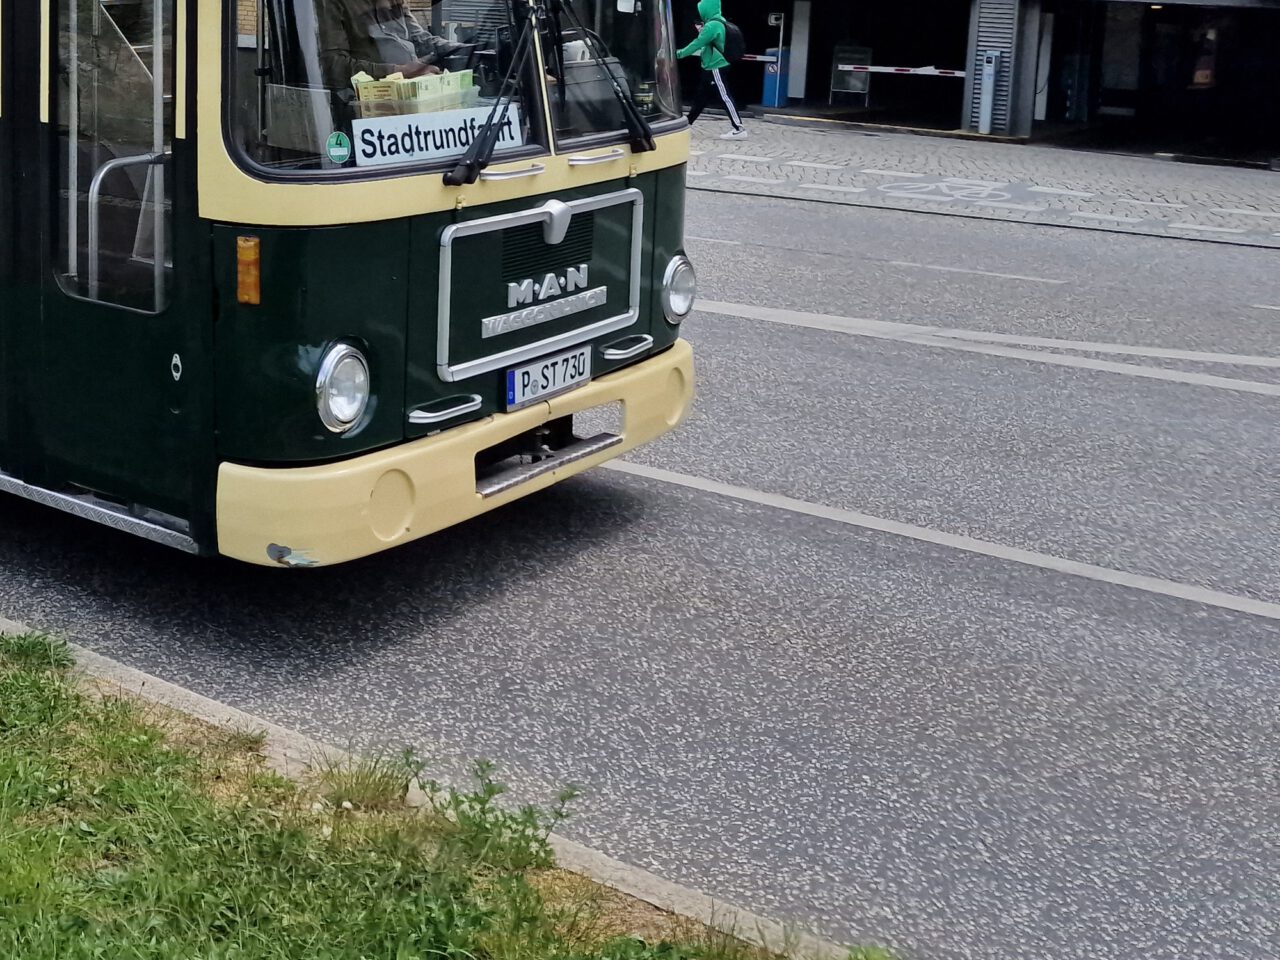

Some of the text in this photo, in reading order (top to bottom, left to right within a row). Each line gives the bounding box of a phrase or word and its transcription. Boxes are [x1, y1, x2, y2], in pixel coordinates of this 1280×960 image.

[335, 134, 342, 147] 4
[361, 116, 515, 159] Stadtrundfrt
[522, 371, 530, 397] P
[541, 362, 558, 390] ST
[562, 352, 585, 382] 730
